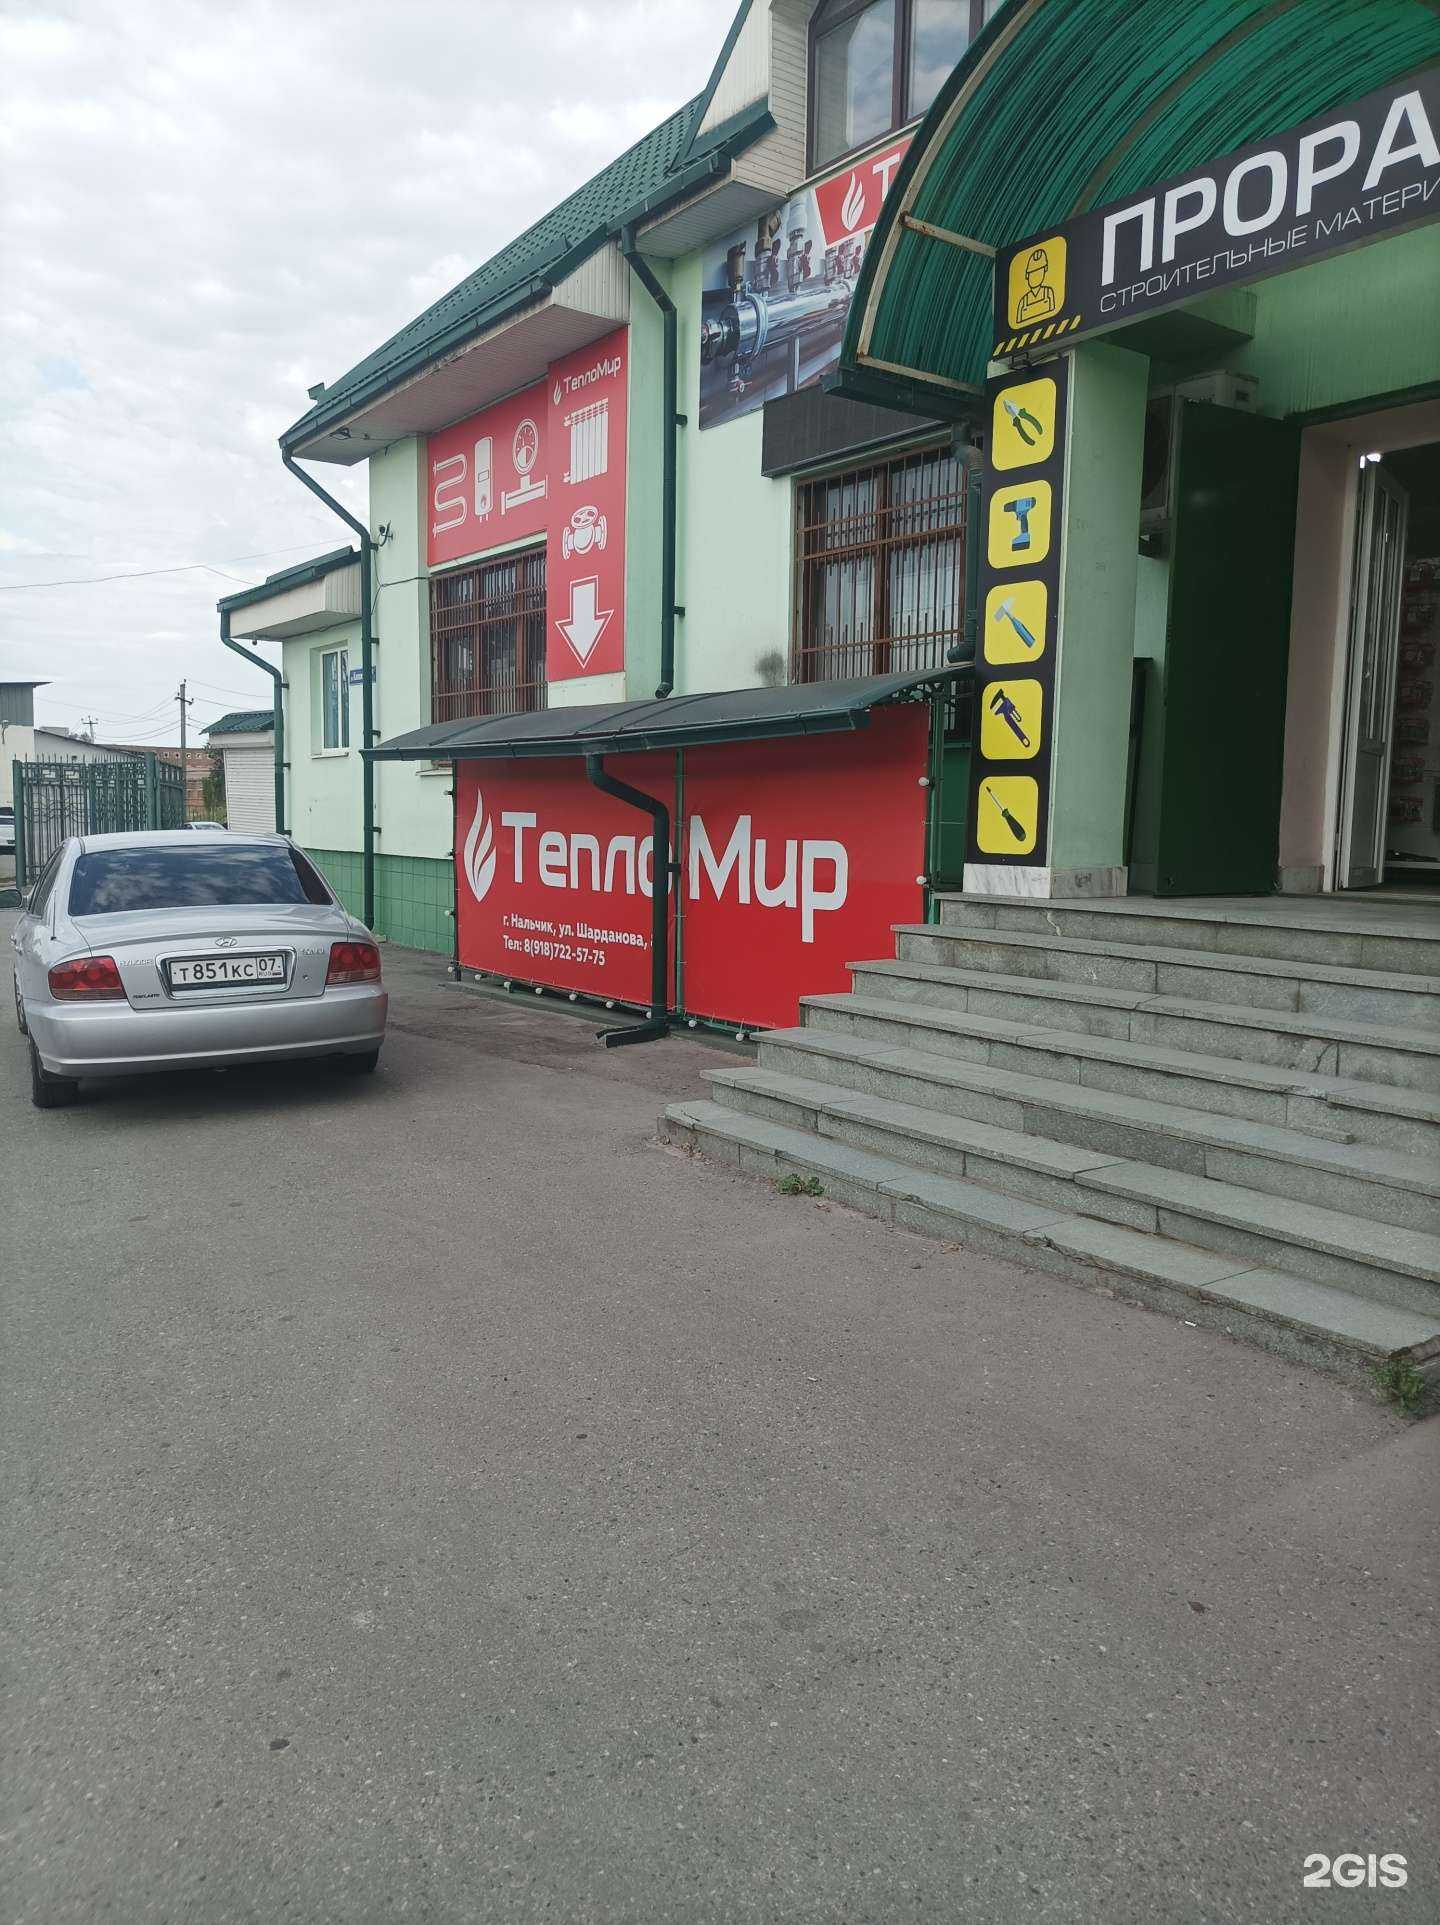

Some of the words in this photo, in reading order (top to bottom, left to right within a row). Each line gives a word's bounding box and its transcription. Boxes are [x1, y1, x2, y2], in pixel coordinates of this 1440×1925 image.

[1101, 90, 1440, 286] ПРОРА
[1099, 225, 1308, 313] СТРОИТЕЛЬНЫЕ
[563, 356, 621, 394] ТеплоМир
[503, 915, 509, 926] г.
[511, 913, 556, 935] Нальчик,
[558, 923, 574, 938] ул.
[576, 922, 648, 950] Шарданова,
[259, 958, 276, 971] 07
[502, 935, 522, 952] Тел:
[523, 938, 606, 966] 8(918)722-57-75
